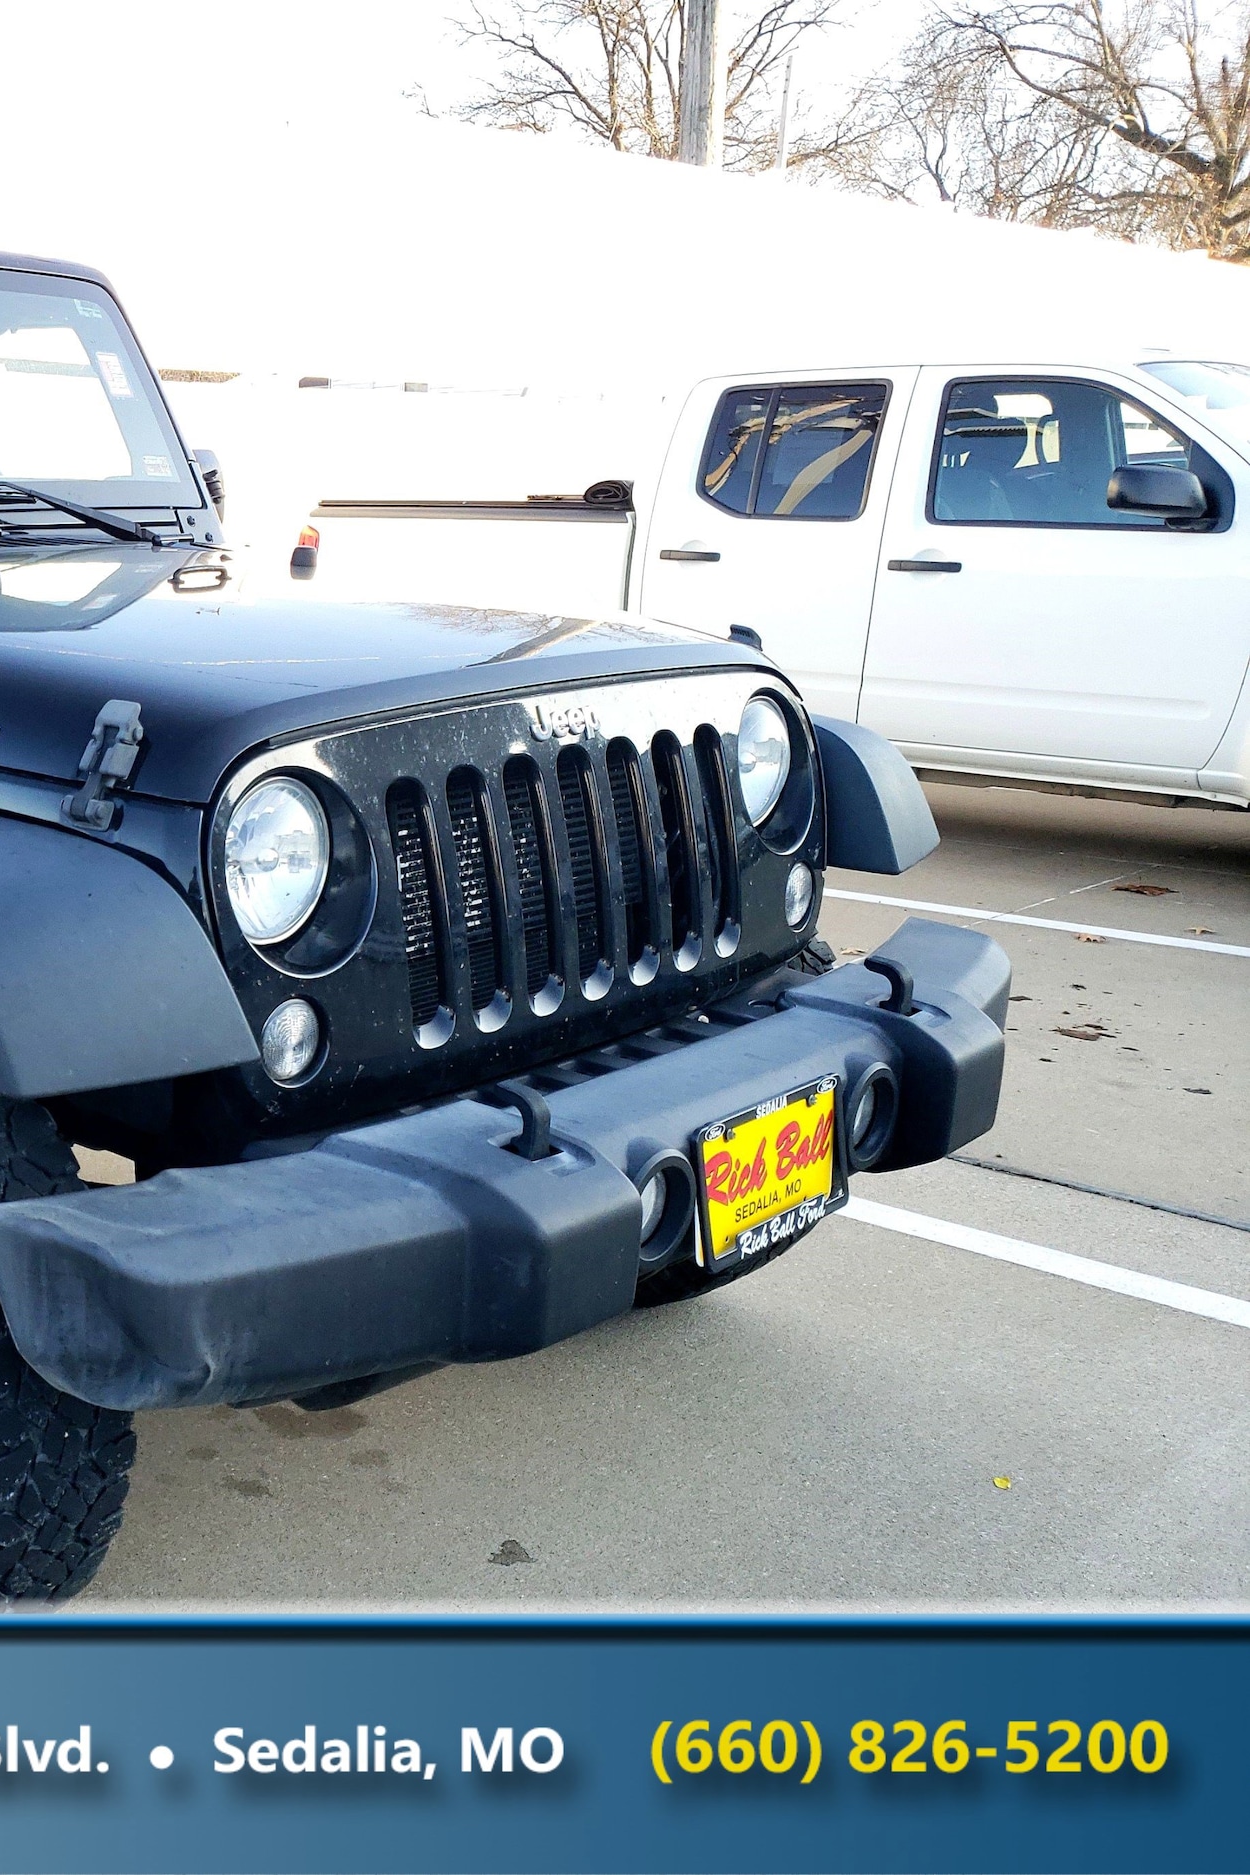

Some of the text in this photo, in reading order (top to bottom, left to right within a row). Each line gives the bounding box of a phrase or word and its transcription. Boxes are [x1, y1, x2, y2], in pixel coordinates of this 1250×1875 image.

[530, 704, 601, 742] Jeep
[755, 1096, 788, 1119] SEDALIA
[705, 1108, 834, 1206] Rick Ball
[734, 1178, 802, 1223] SEDALIA, MO
[740, 1197, 826, 1259] Rick Ball Ford
